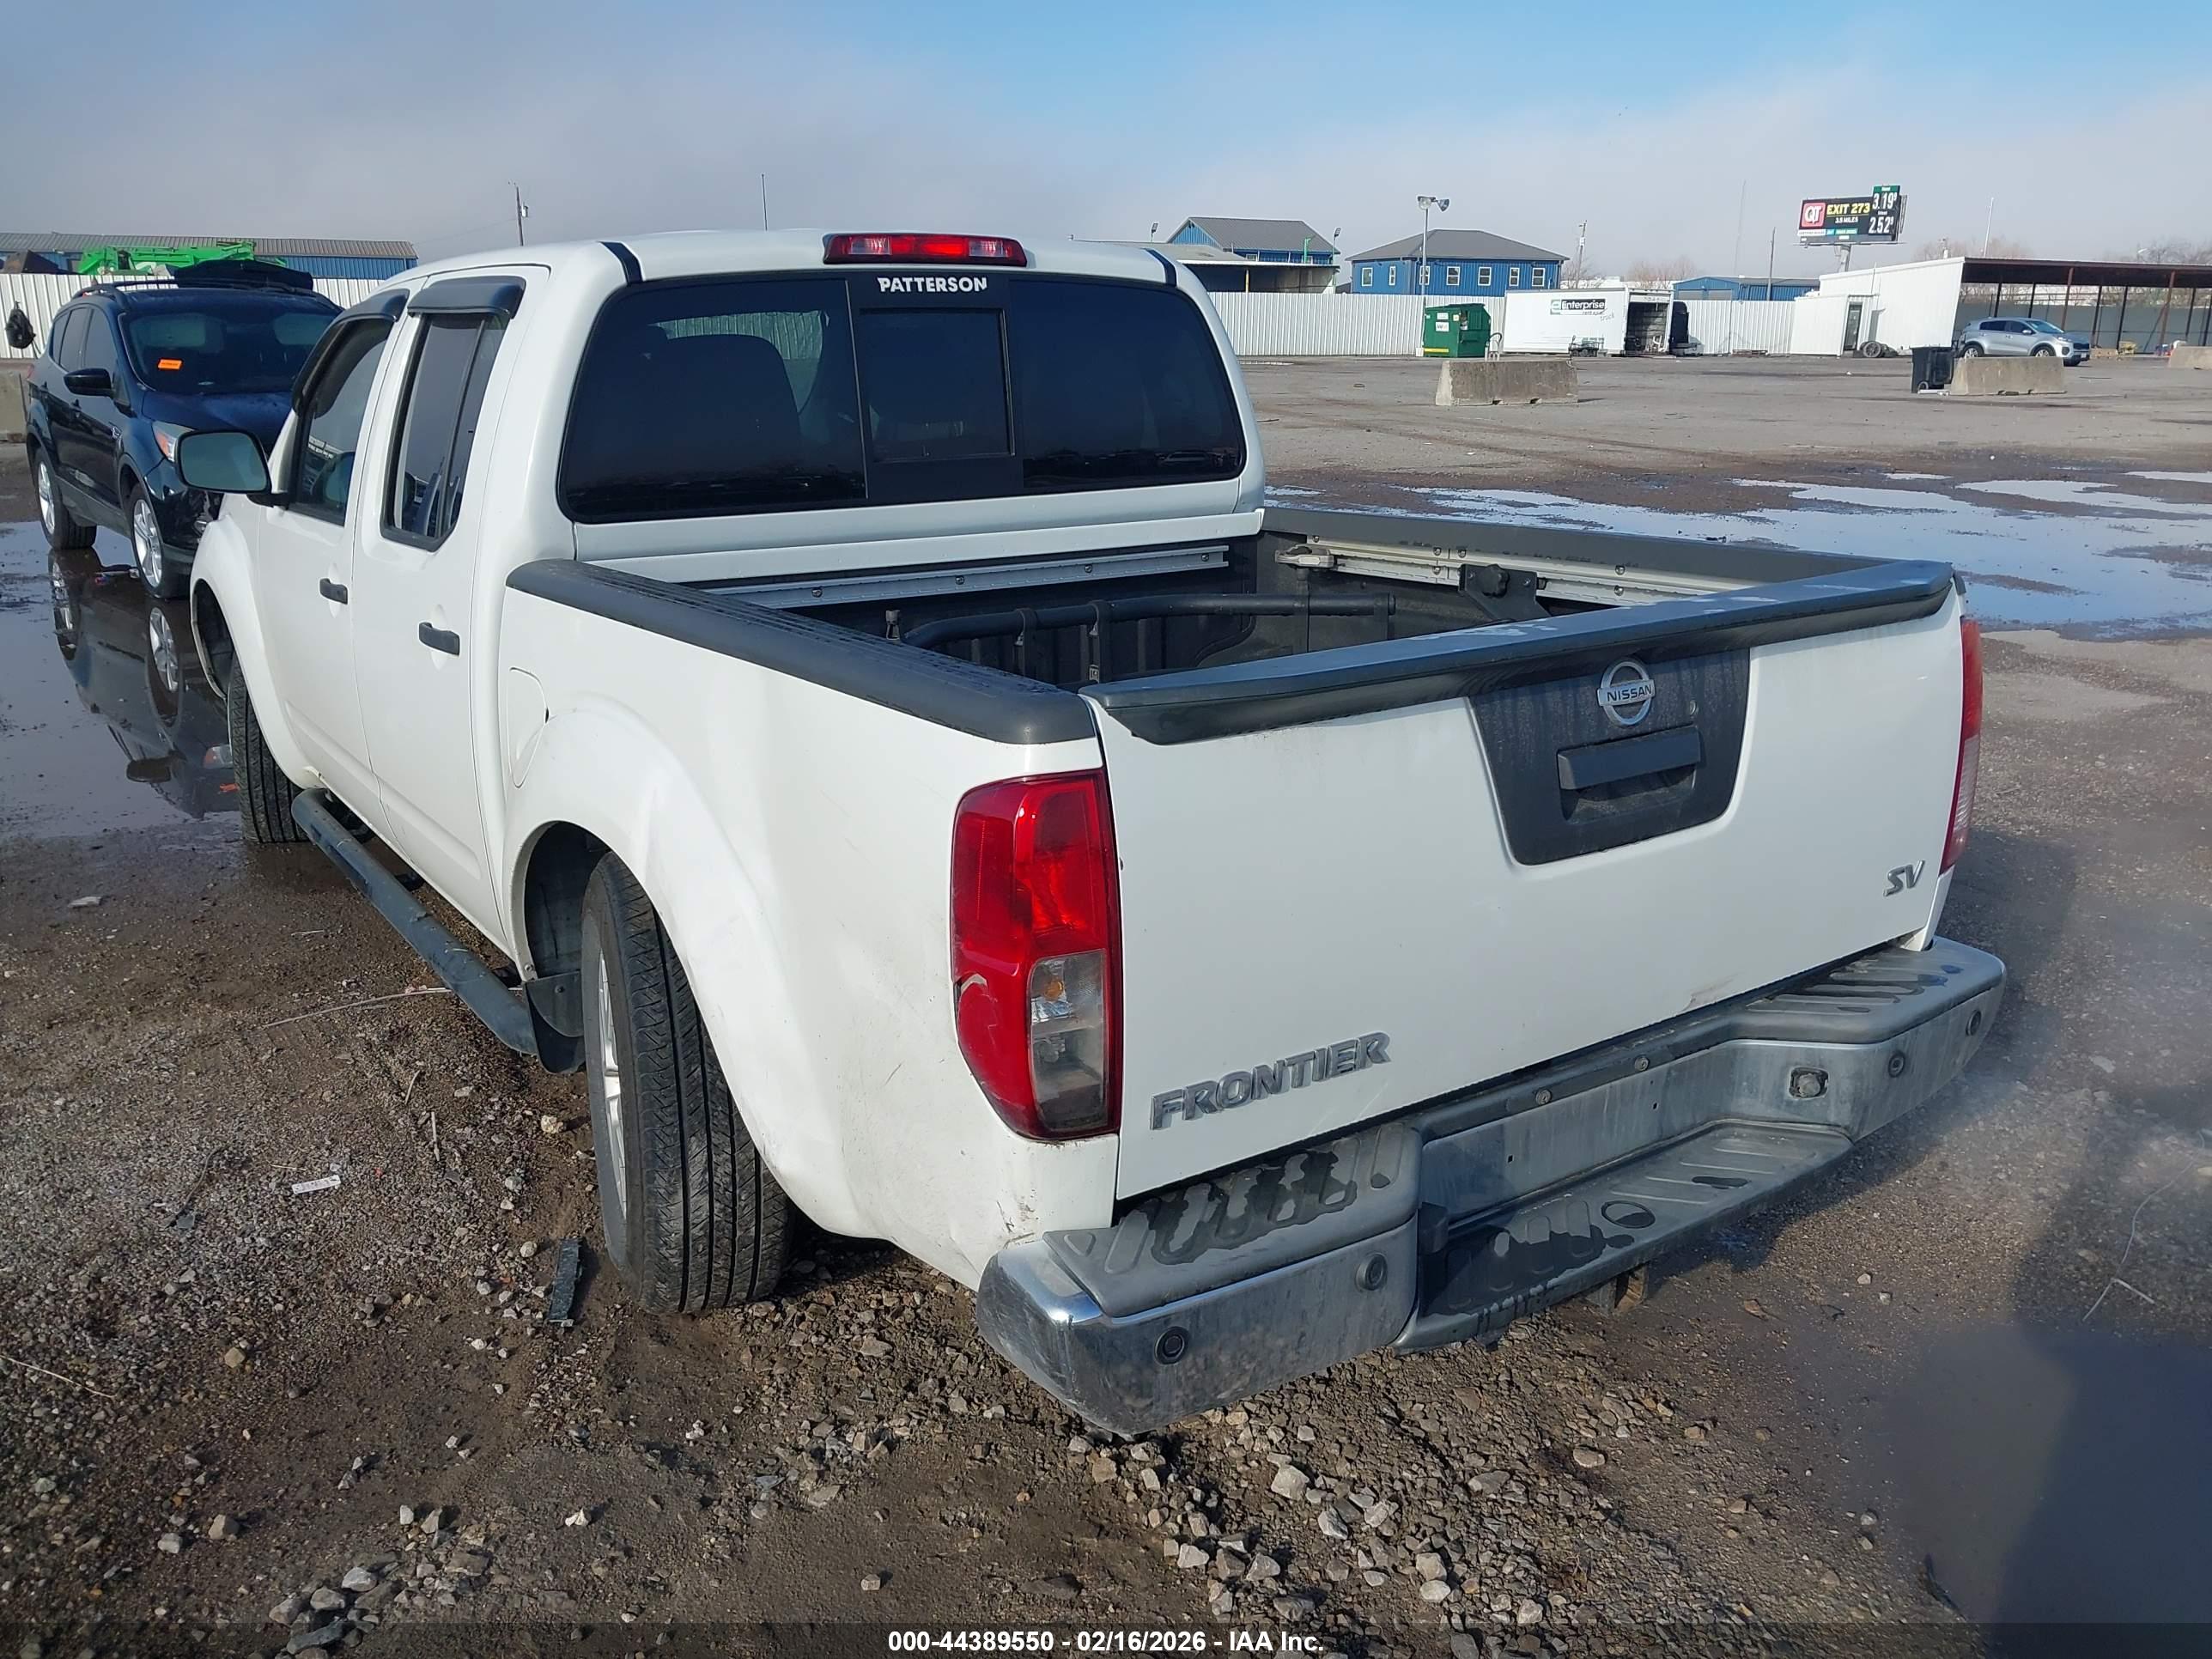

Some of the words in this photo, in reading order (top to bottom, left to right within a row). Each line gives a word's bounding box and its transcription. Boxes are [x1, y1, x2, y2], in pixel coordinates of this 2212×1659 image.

[1805, 205, 1822, 224] QT
[1826, 204, 1850, 215] EXIT
[1850, 202, 1870, 214] 273
[877, 276, 987, 292] PATTERSON
[1561, 300, 1605, 310] Enterprise
[1607, 684, 1653, 702] NISSAN
[1883, 860, 1925, 897] SV
[1150, 1031, 1391, 1130] FRONTIER
